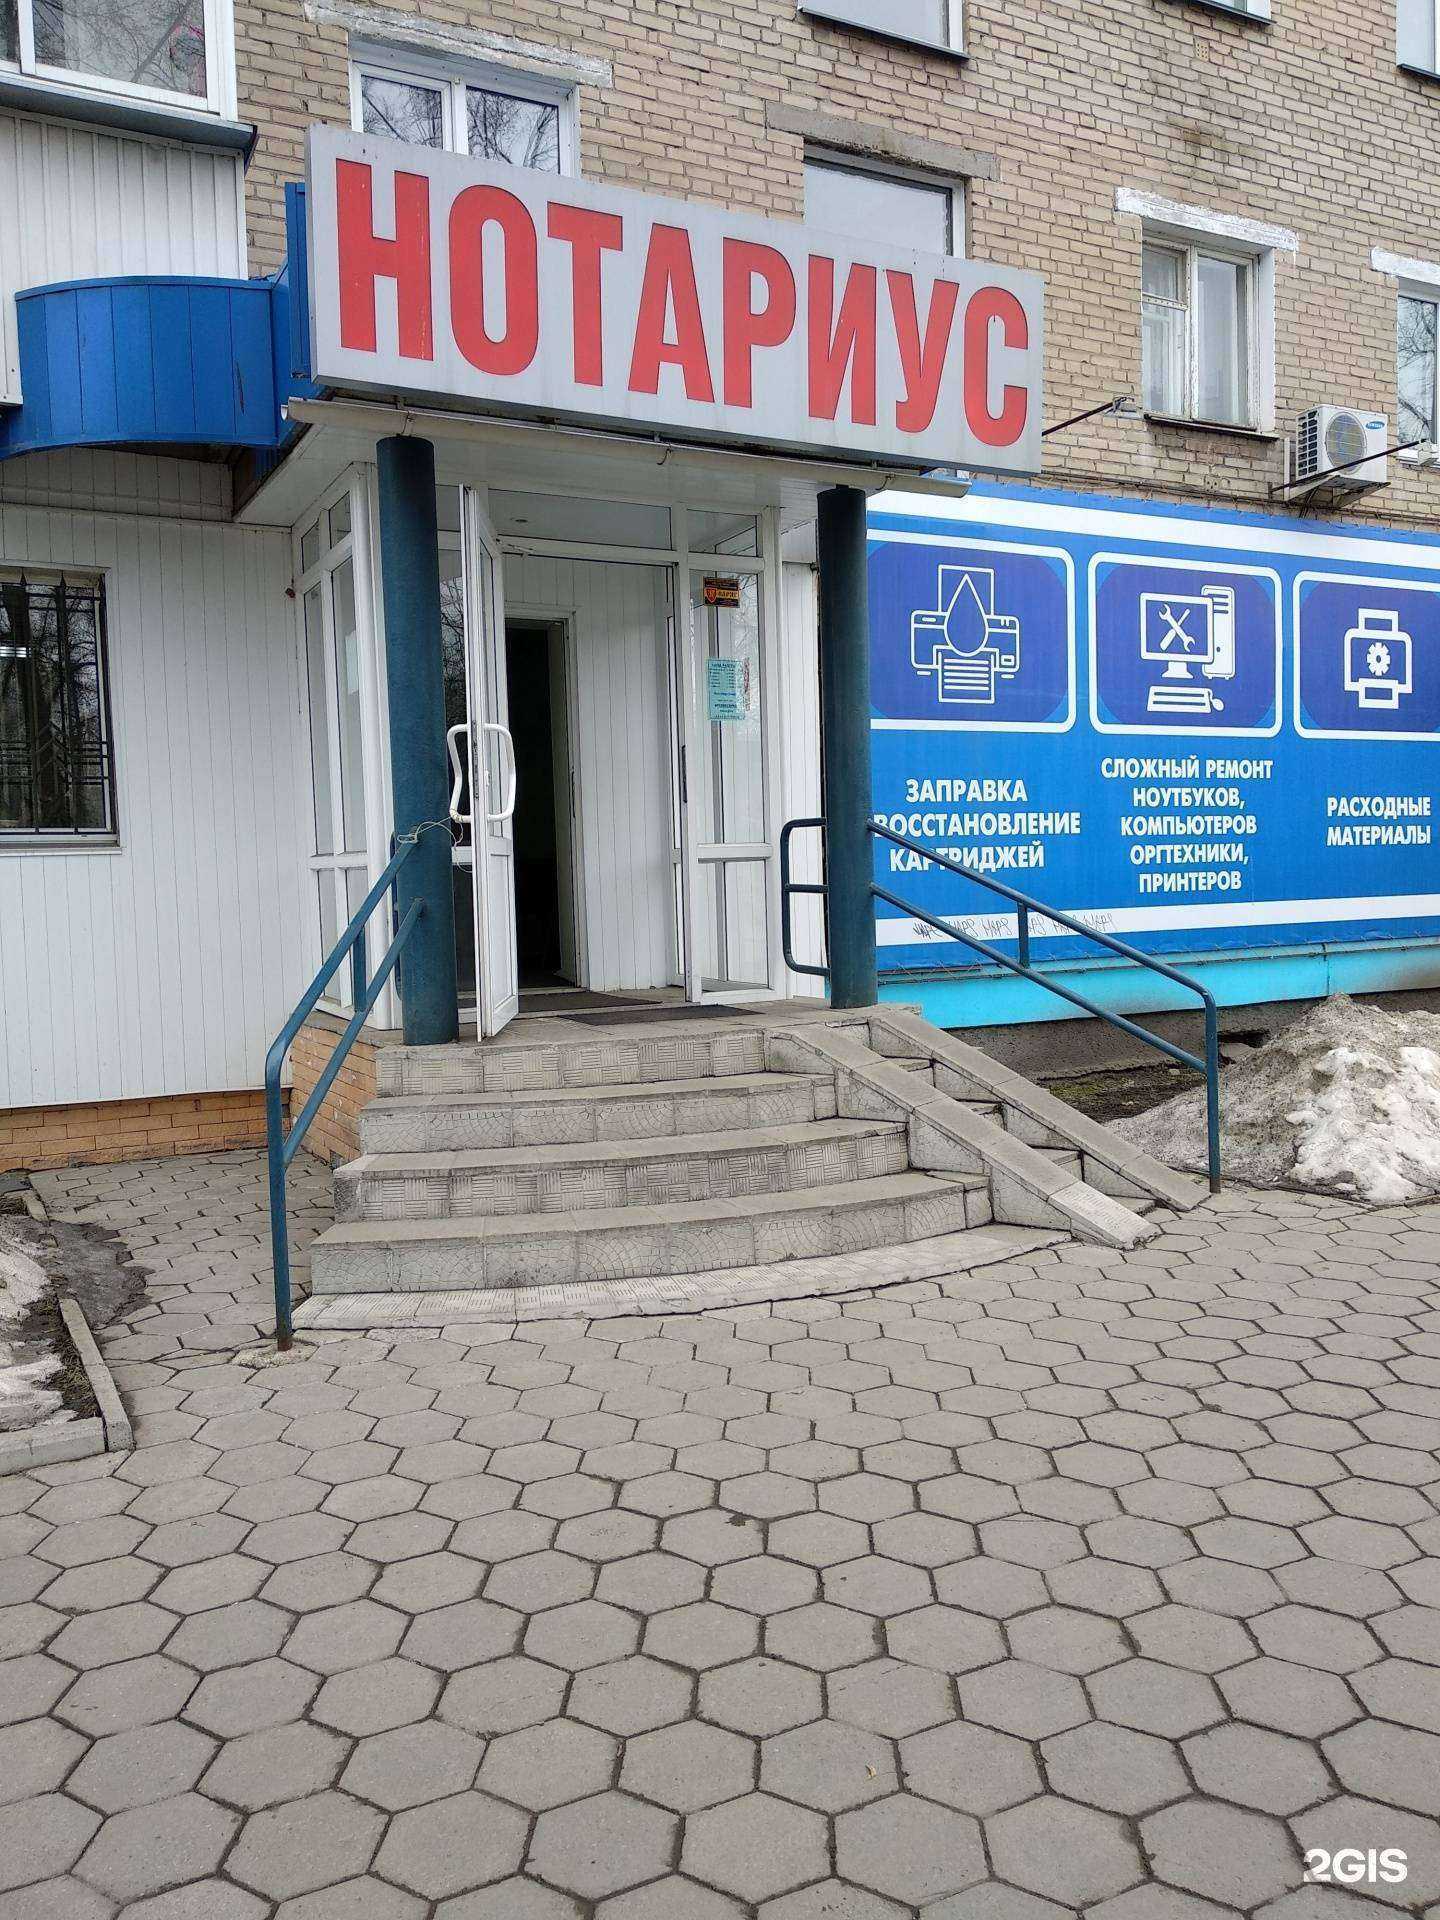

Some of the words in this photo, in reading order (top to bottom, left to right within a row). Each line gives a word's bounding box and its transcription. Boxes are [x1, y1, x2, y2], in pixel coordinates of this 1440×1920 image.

[336, 158, 1029, 447] НОТАРИУС
[1101, 754, 1200, 779] СЛОЖНЫЙ
[1205, 759, 1273, 779] РЕМОНТ
[905, 778, 1028, 803] ЗАПРАВКА
[1133, 786, 1245, 809] НОУТБУКОВ,
[1327, 796, 1431, 820] РАСХОДНЫЕ
[873, 812, 1081, 839] ВОССТАНОВЛЕНИЕ
[1120, 814, 1258, 836] КОМПЬЮТЕРОВ
[1326, 825, 1431, 846] МАТЕРИАЛЫ
[1130, 843, 1249, 865] ОРГТЕХНИКИ,
[1139, 870, 1242, 893] ПРИНТЕРОВ
